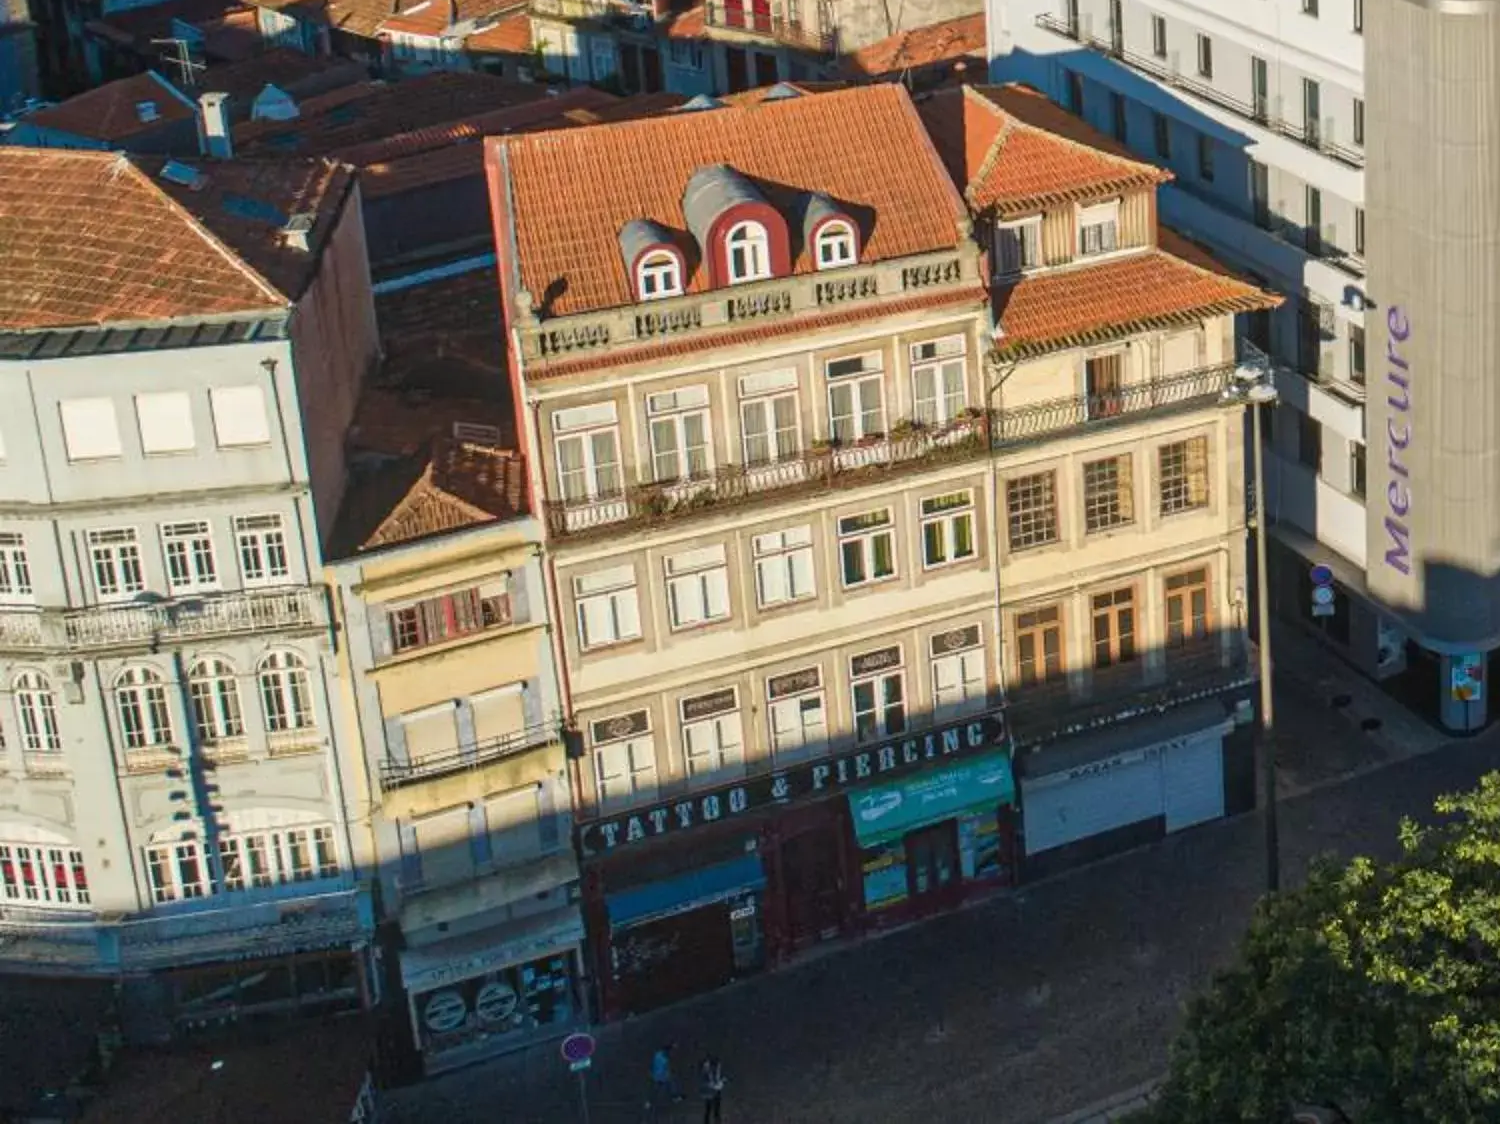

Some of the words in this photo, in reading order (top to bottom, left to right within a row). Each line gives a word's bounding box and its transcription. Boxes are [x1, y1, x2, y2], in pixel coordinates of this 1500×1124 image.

[1383, 303, 1412, 577] Mercure
[600, 787, 748, 848] TATTOO
[771, 772, 790, 802] &
[812, 722, 985, 791] PIERCING
